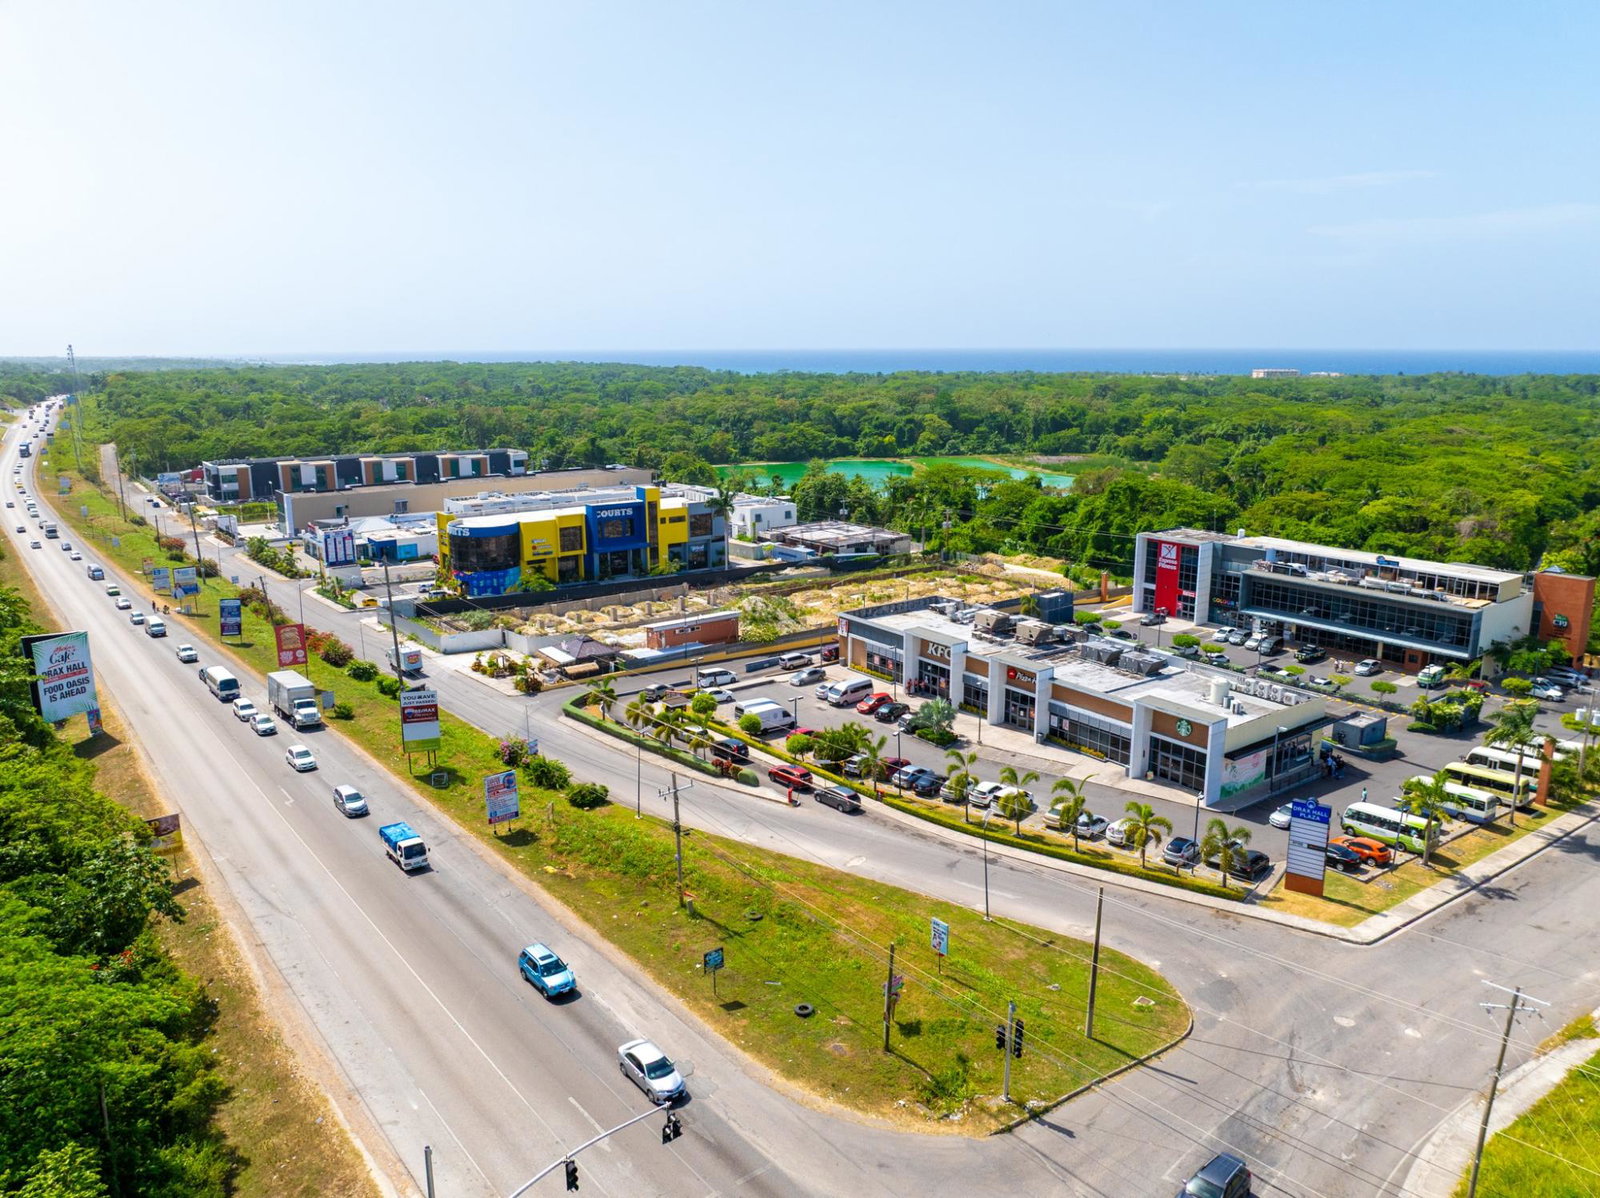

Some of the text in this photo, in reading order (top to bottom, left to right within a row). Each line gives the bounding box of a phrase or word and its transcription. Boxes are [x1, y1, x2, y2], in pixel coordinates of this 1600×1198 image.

[596, 507, 633, 518] COURTS
[927, 641, 951, 660] KFC
[66, 661, 88, 673] HALL
[43, 683, 64, 696] FOOD
[66, 676, 90, 689] OASIS
[49, 686, 87, 703] IS AHEAD
[1292, 805, 1328, 818] DRAX HALL
[1299, 812, 1321, 821] PLAZA
